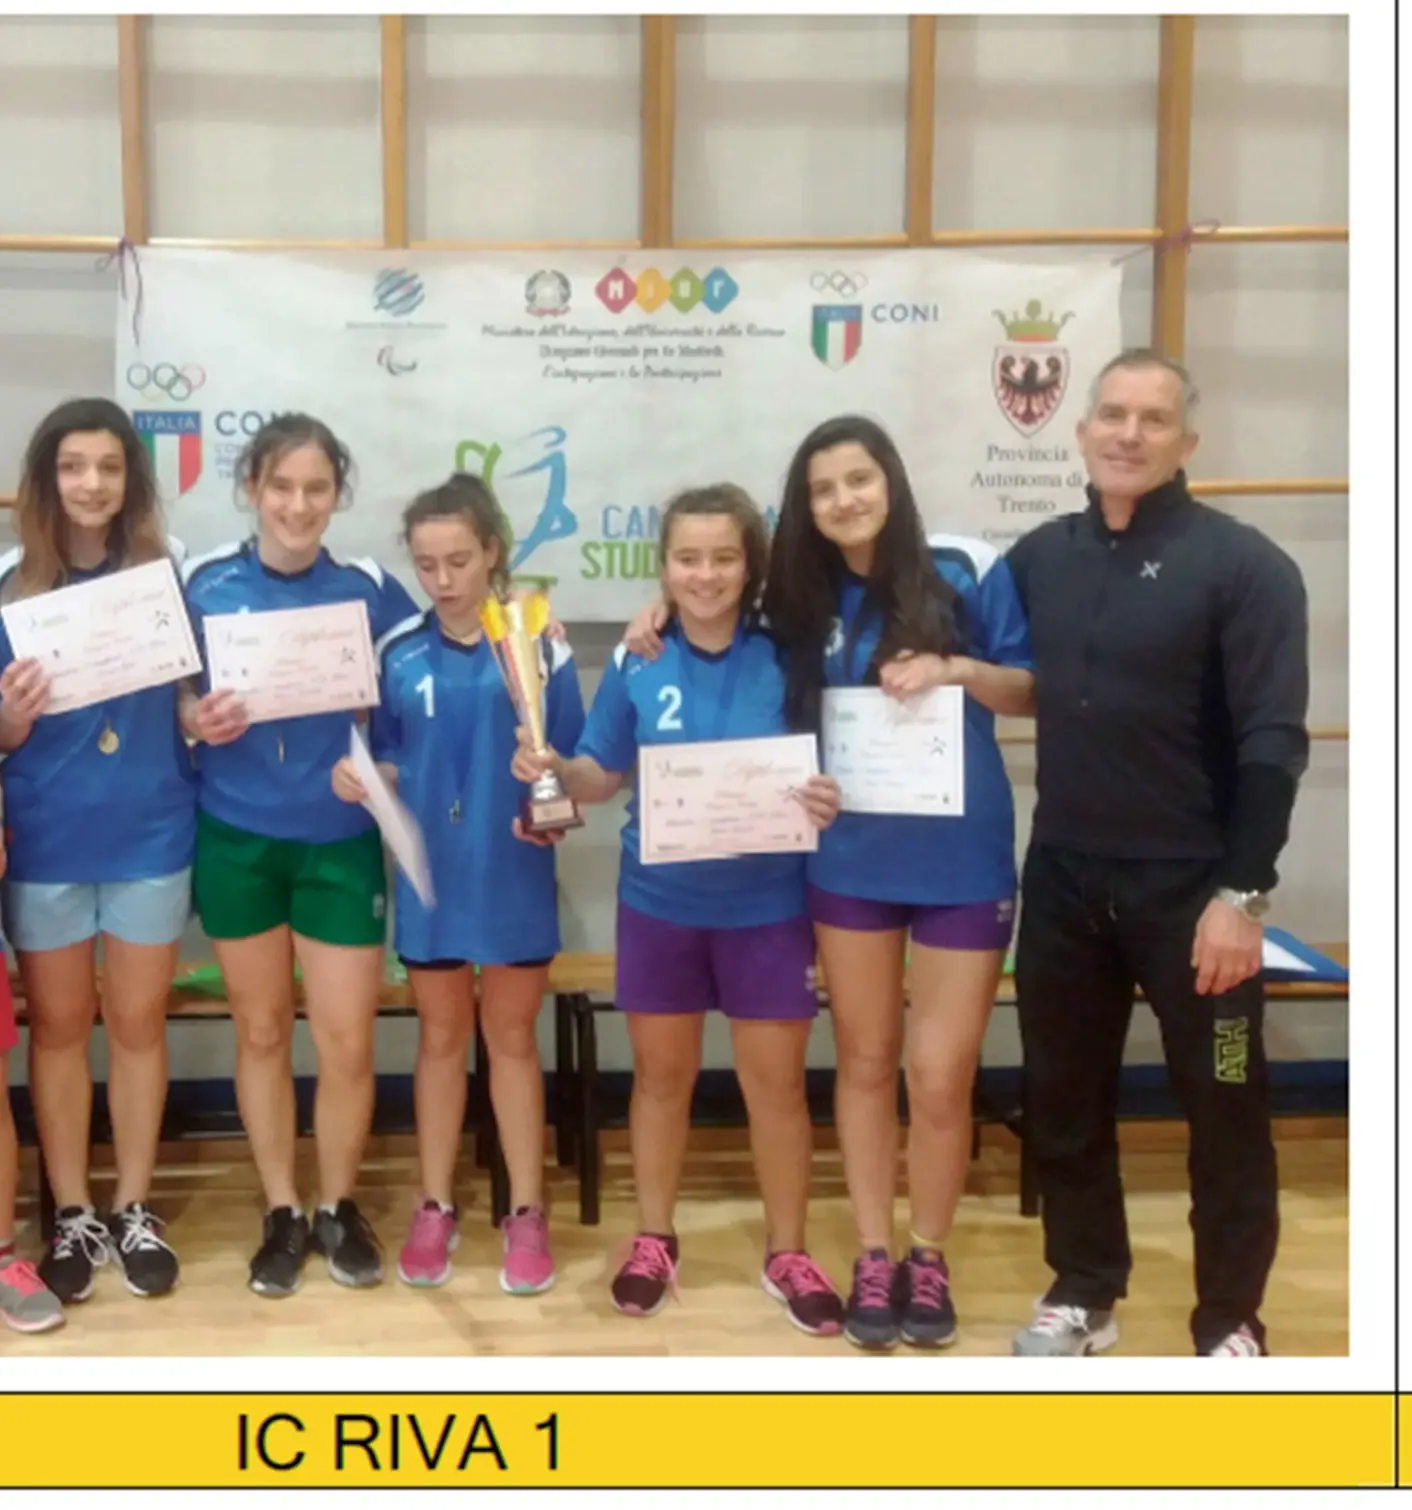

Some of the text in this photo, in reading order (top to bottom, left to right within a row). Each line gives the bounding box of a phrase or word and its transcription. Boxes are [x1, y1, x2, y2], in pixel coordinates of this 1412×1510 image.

[870, 303, 939, 323] CONI
[137, 415, 197, 430] ITALIA
[214, 410, 265, 436] CO
[986, 444, 1070, 462] Provincia
[970, 470, 1063, 488] Autonoma
[996, 494, 1058, 514] Trento
[415, 674, 435, 718] 1
[656, 685, 683, 731] 2
